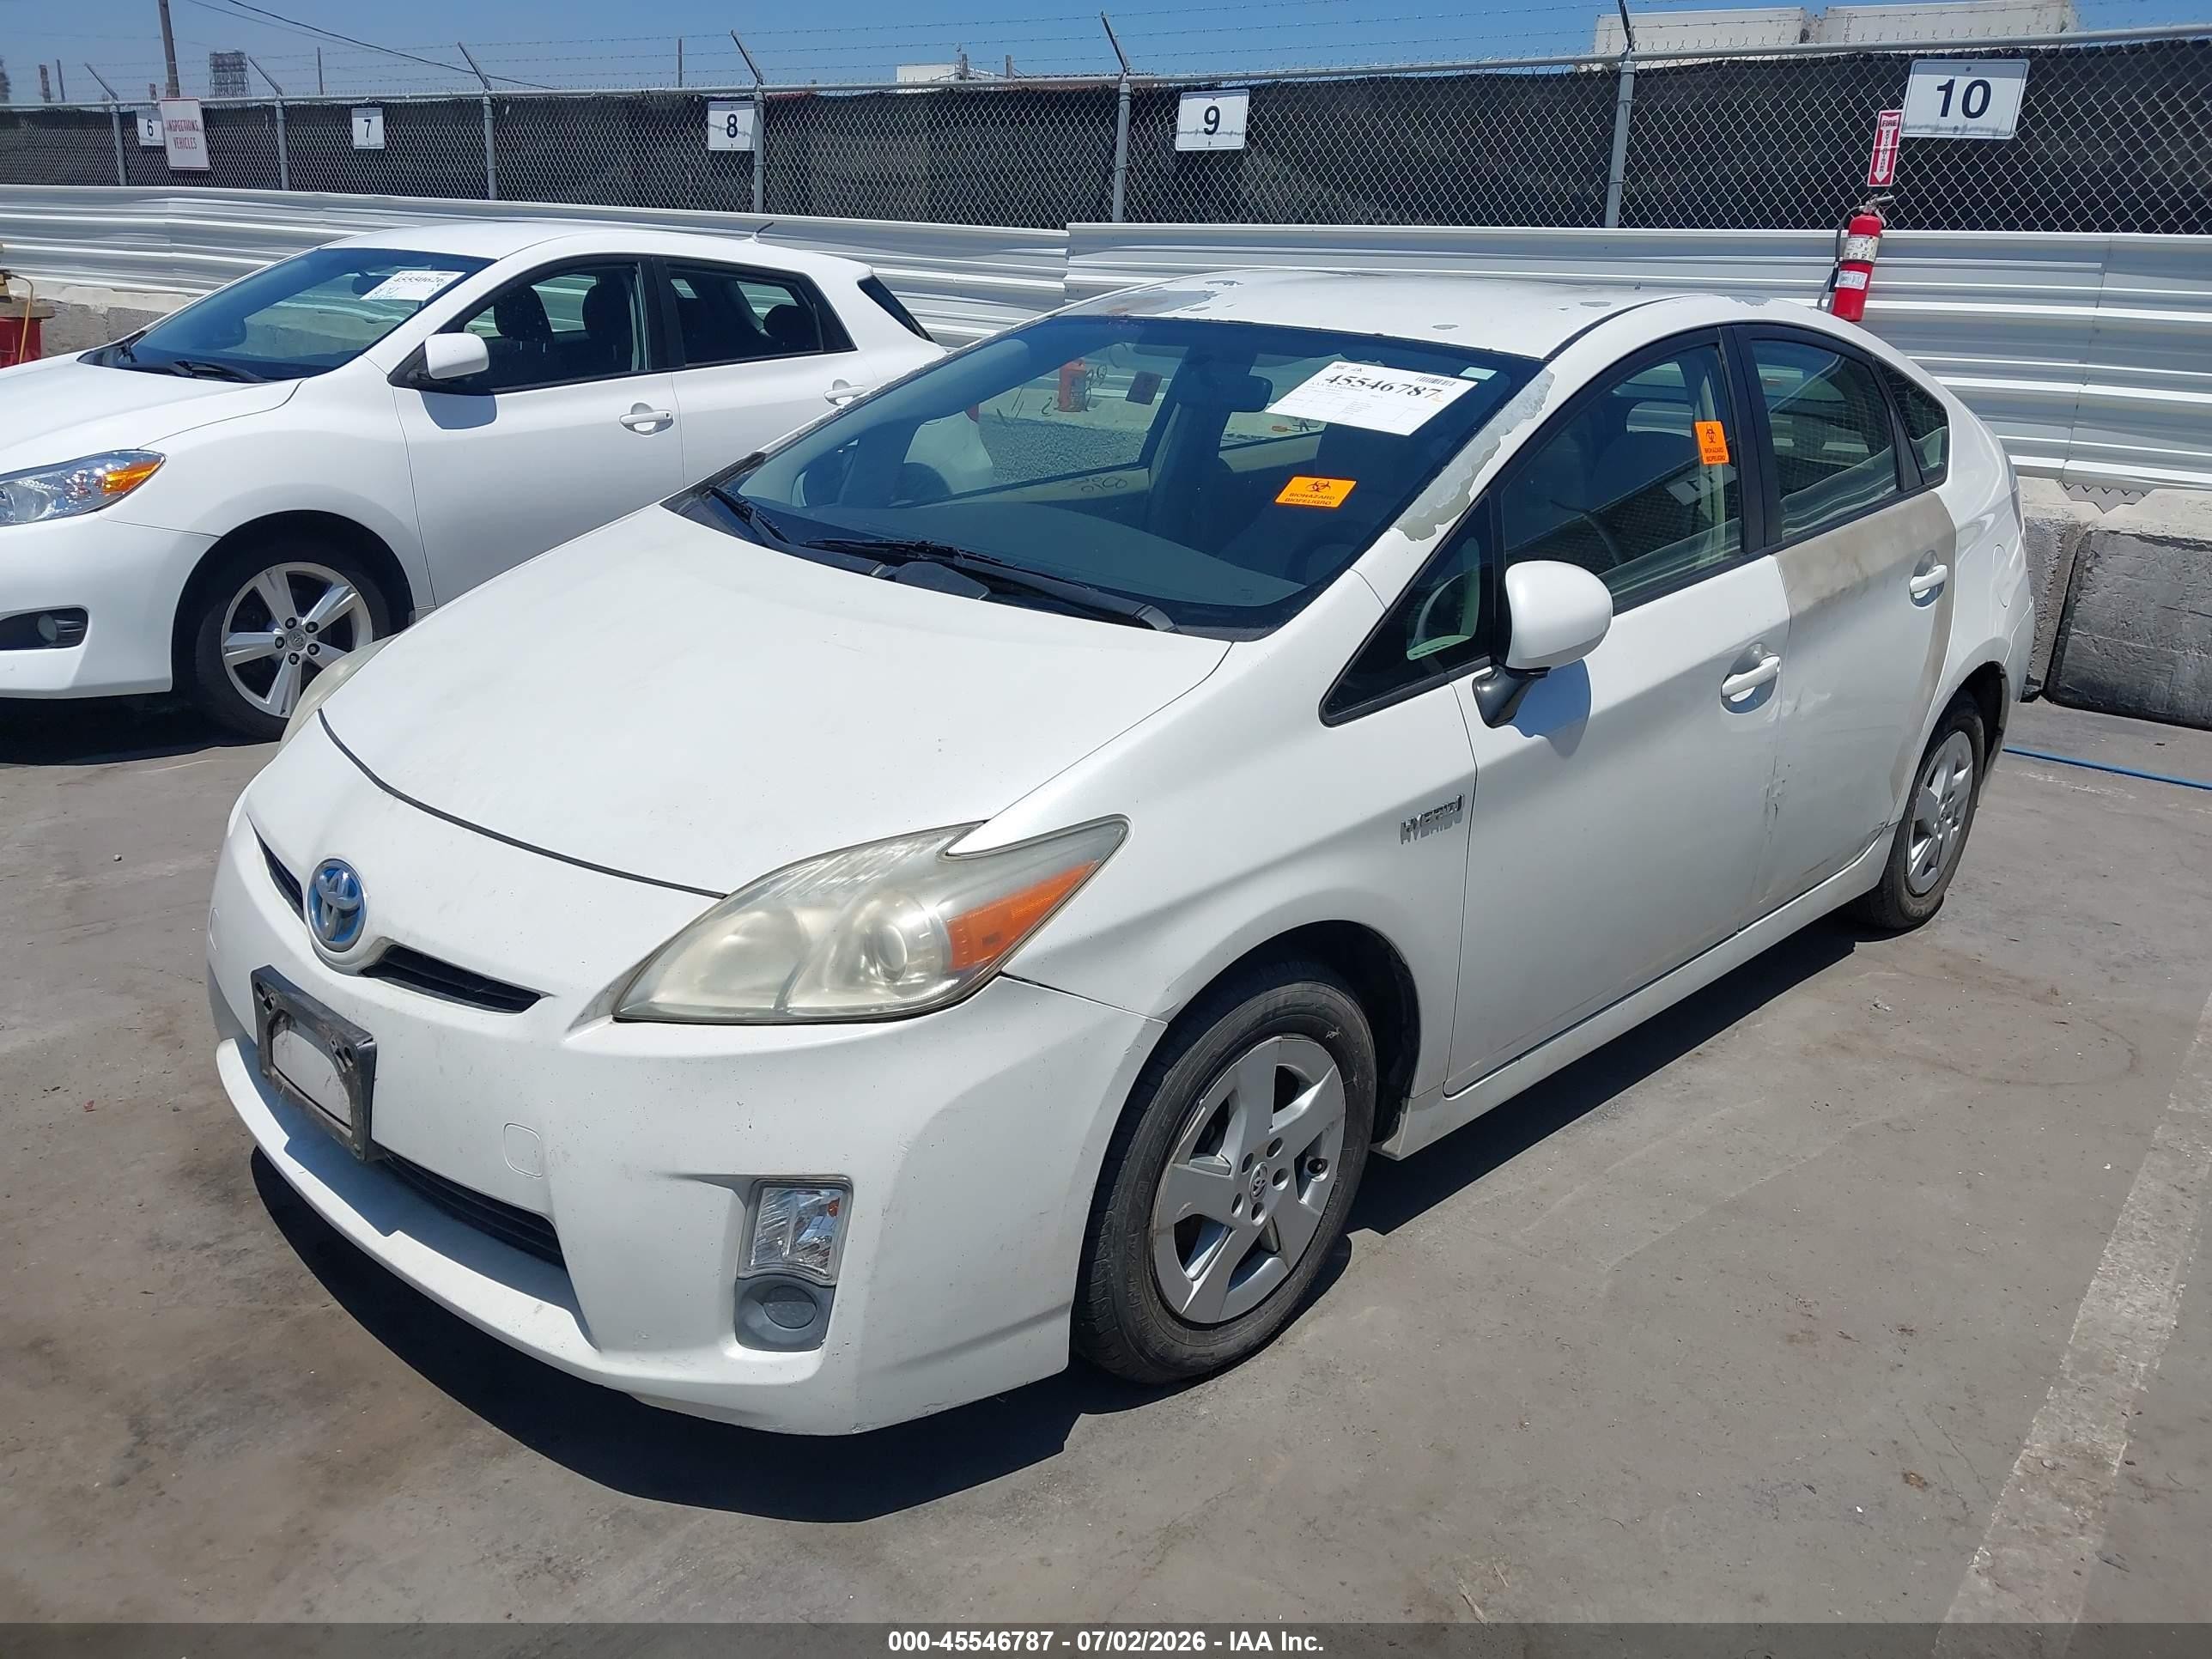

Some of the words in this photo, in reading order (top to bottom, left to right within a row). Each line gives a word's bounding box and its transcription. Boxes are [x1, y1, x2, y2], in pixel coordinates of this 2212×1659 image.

[1936, 78, 1991, 118] 10
[147, 118, 154, 137] 6
[363, 118, 372, 138] 7
[726, 113, 738, 139] 8
[1203, 105, 1220, 136] 9
[173, 137, 198, 150] VEHICLES
[1325, 374, 1443, 398] 45546787
[1284, 497, 1333, 506] BIOPELIGRO
[1288, 492, 1336, 501] BIOHAZARD
[1400, 793, 1464, 836] HYBRID
